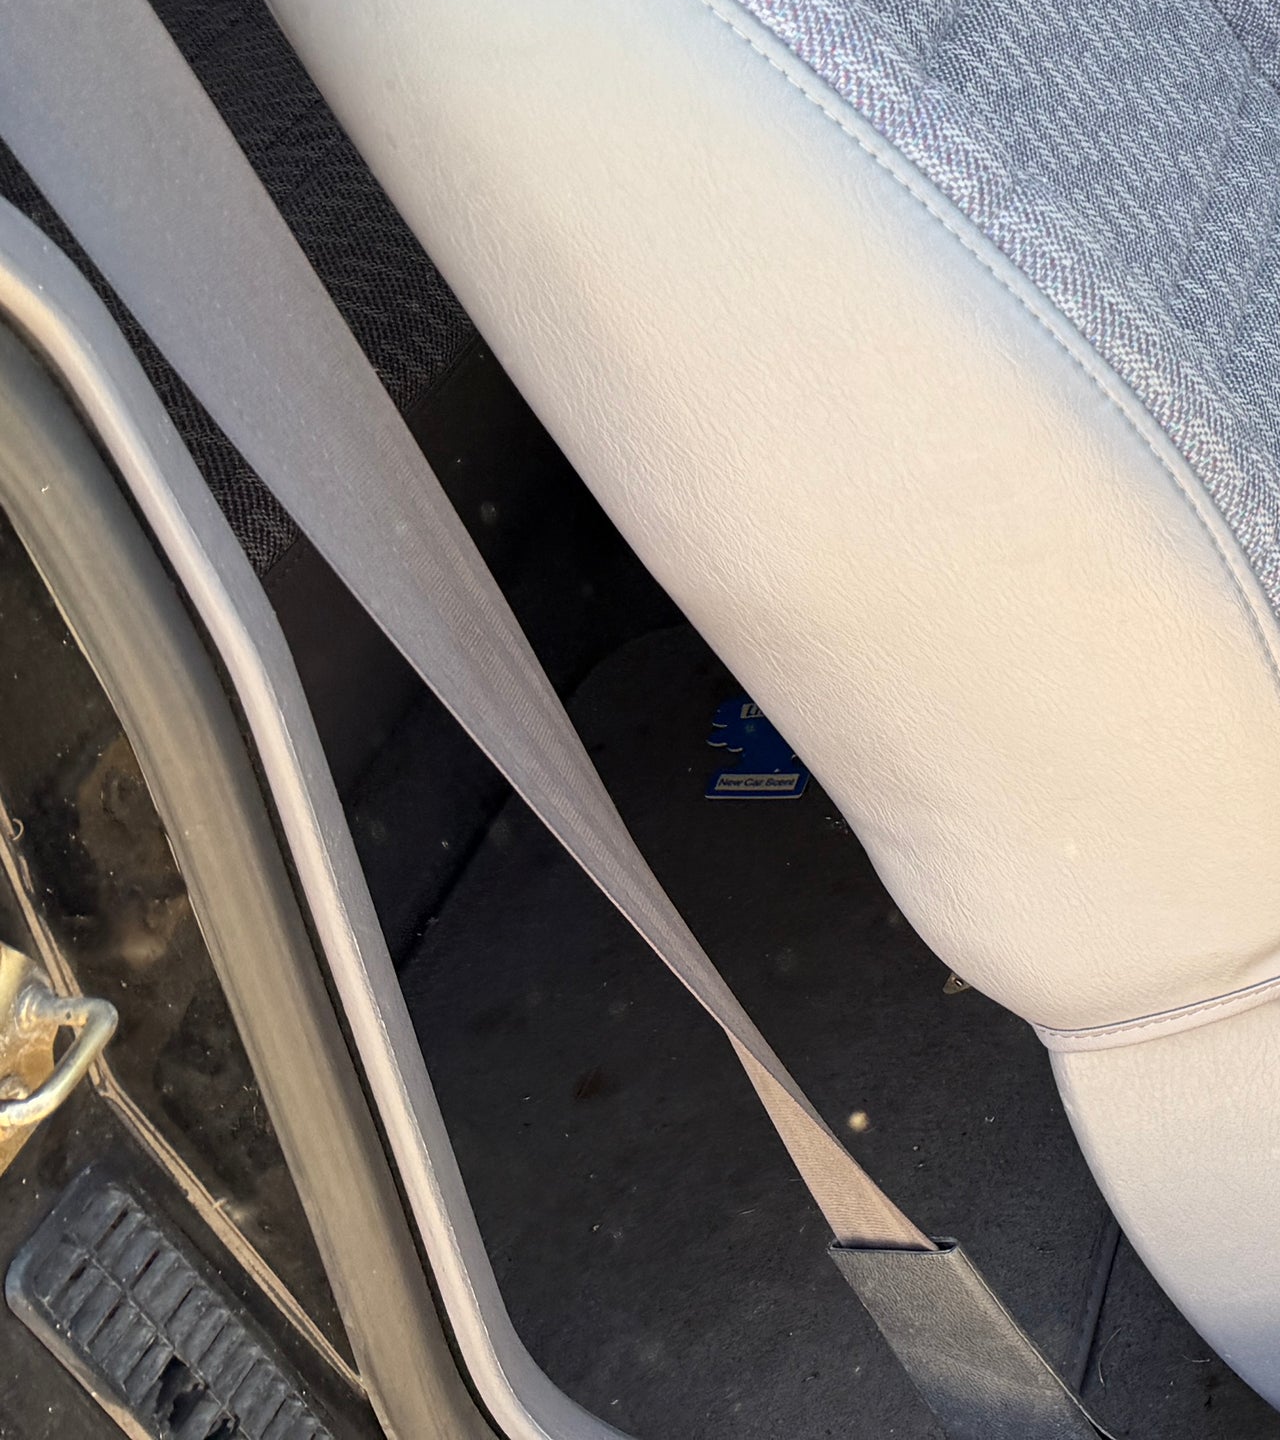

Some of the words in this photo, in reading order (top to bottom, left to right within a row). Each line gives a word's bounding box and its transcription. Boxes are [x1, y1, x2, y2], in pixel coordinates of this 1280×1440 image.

[718, 778, 741, 787] New
[744, 777, 762, 787] Car
[765, 777, 796, 787] Scent
